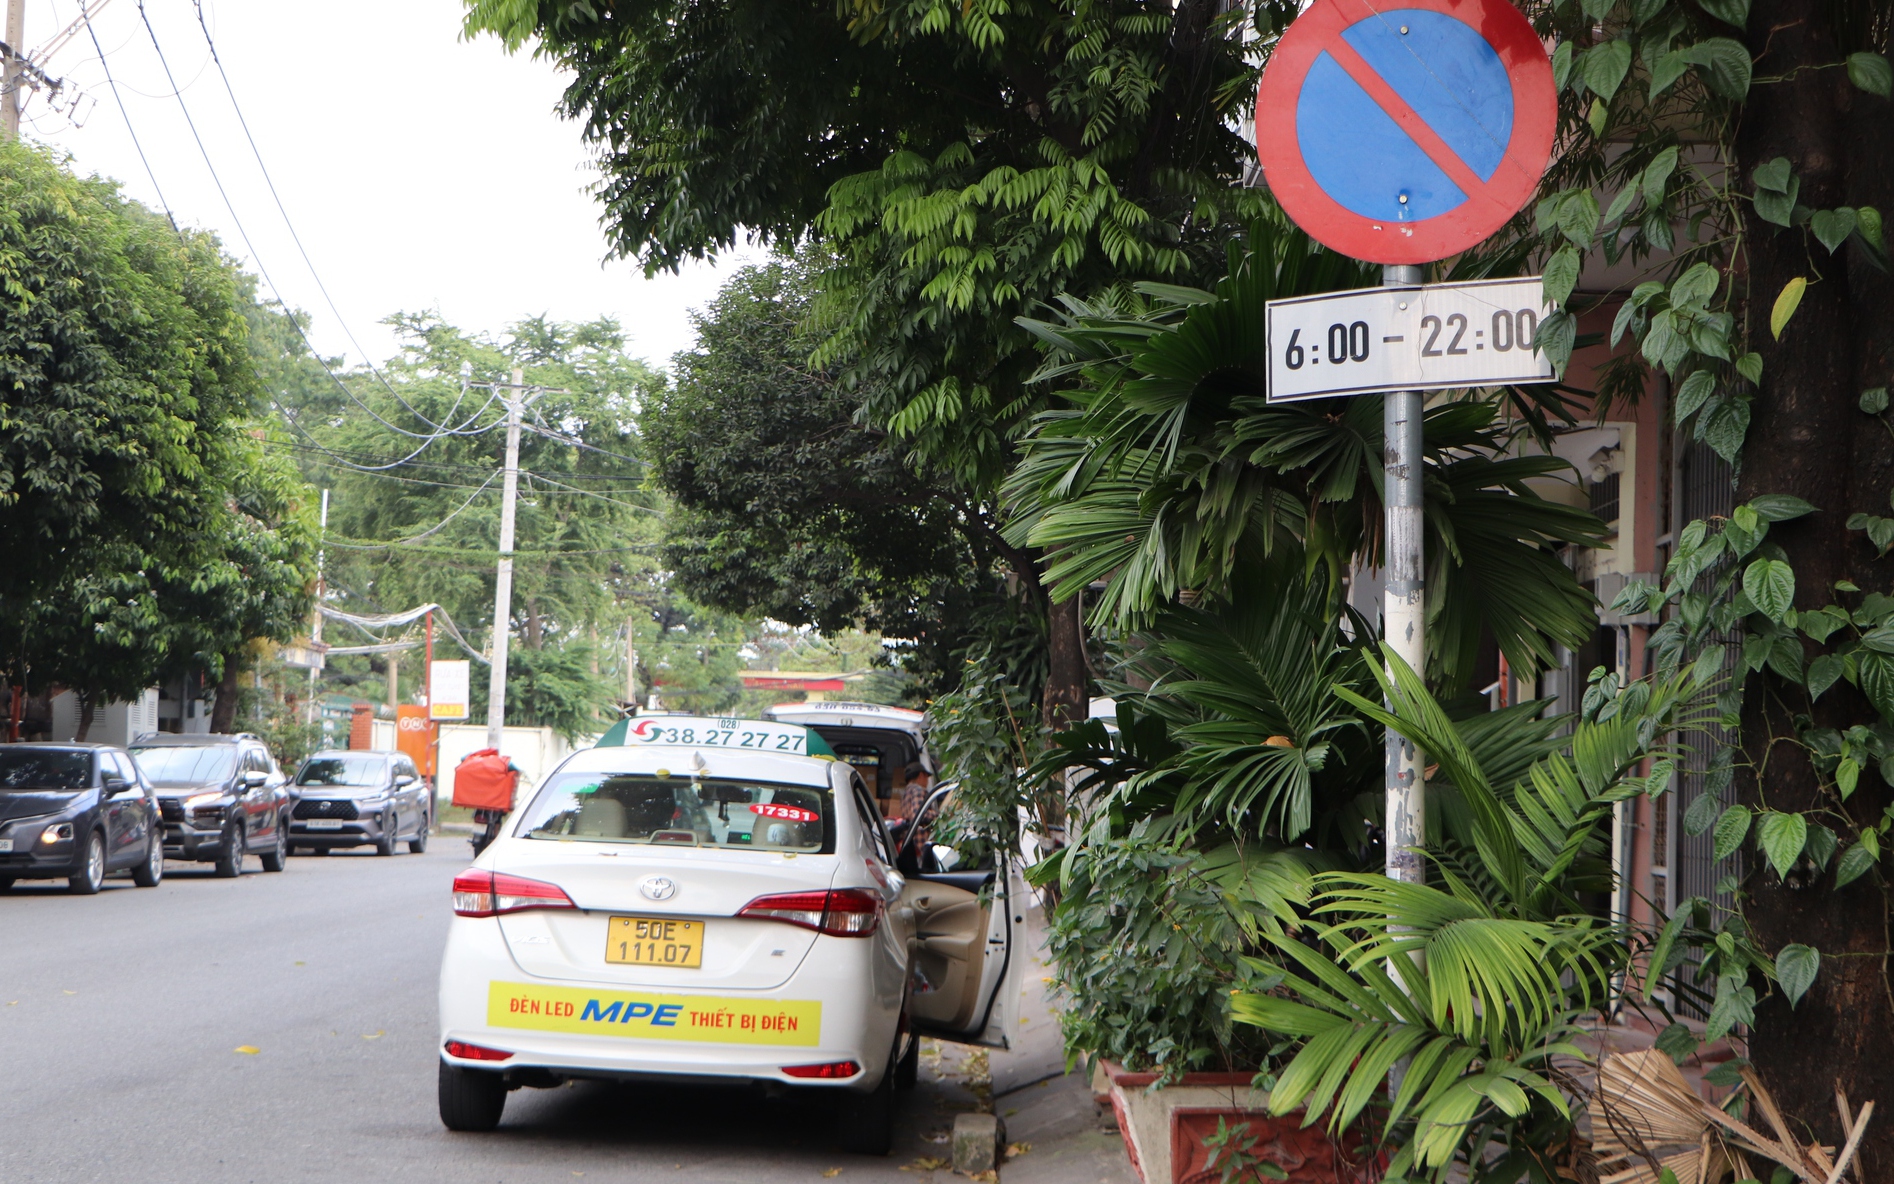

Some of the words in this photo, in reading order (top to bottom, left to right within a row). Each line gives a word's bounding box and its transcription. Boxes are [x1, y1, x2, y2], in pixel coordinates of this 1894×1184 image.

[1285, 321, 1369, 370] 6:00
[1421, 308, 1537, 358] 22:00
[717, 719, 741, 730] (028)
[665, 727, 734, 746] 38.27
[740, 731, 769, 748] 27
[776, 734, 805, 751] 27
[756, 805, 811, 821] 17331
[635, 920, 676, 941] 50E
[619, 941, 691, 964] 111.07
[510, 995, 540, 1014] ĐÈN
[545, 1001, 574, 1017] LED
[580, 999, 684, 1027] MPE
[690, 1007, 735, 1028] THIẾT
[740, 1014, 756, 1033] BỊ
[761, 1012, 798, 1034] ĐIỆN
